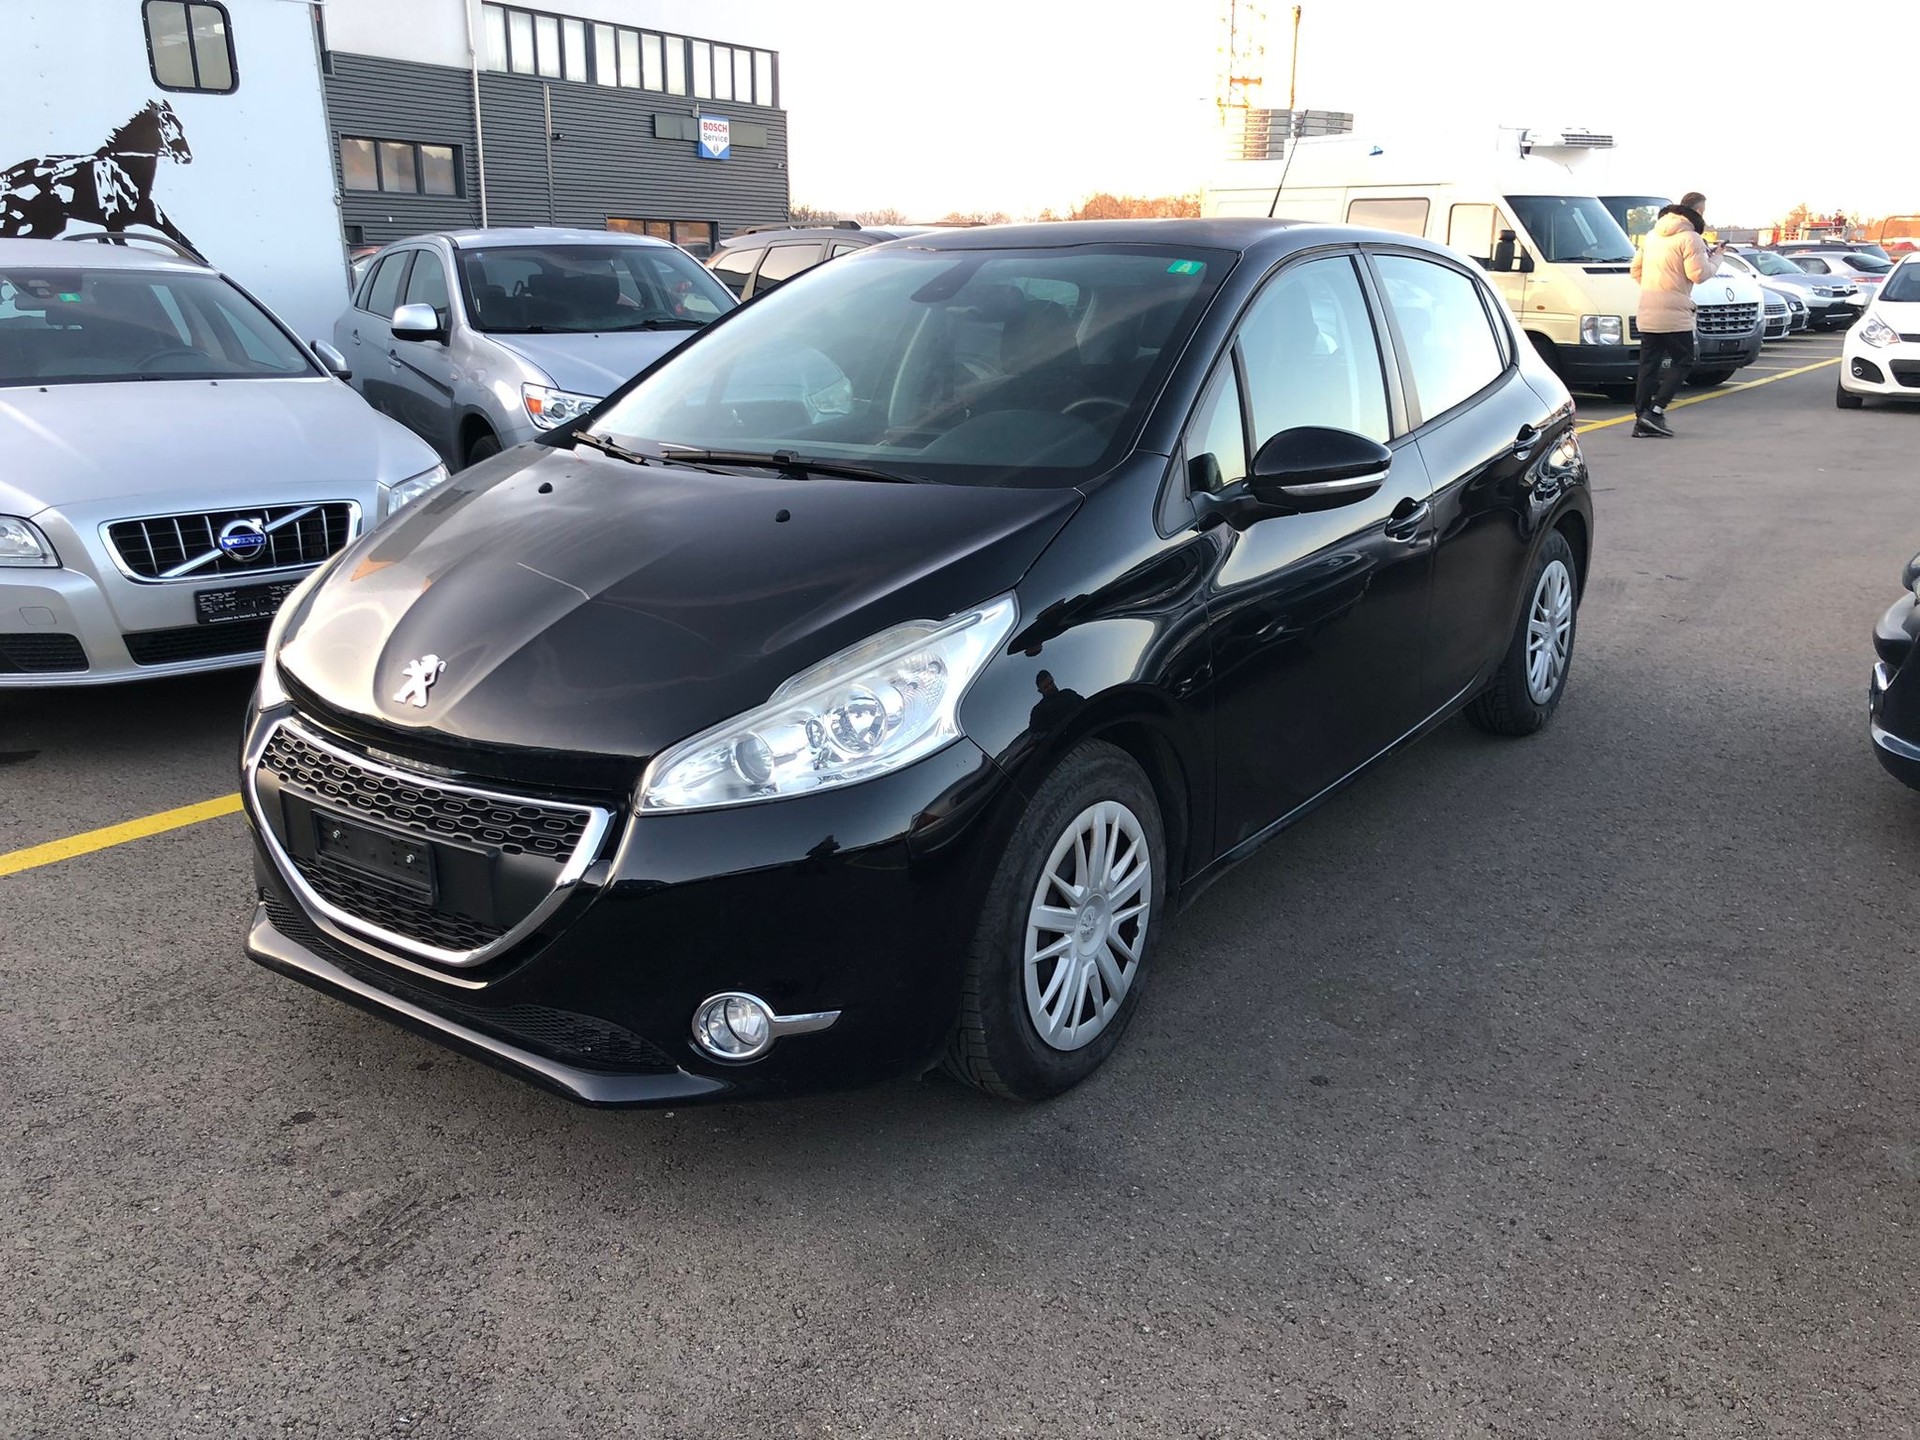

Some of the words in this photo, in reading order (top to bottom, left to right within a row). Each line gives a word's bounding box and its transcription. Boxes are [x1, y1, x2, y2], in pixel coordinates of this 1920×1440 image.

[703, 121, 728, 133] BOSCH
[703, 132, 729, 143] Service
[223, 536, 263, 546] VOLVO
